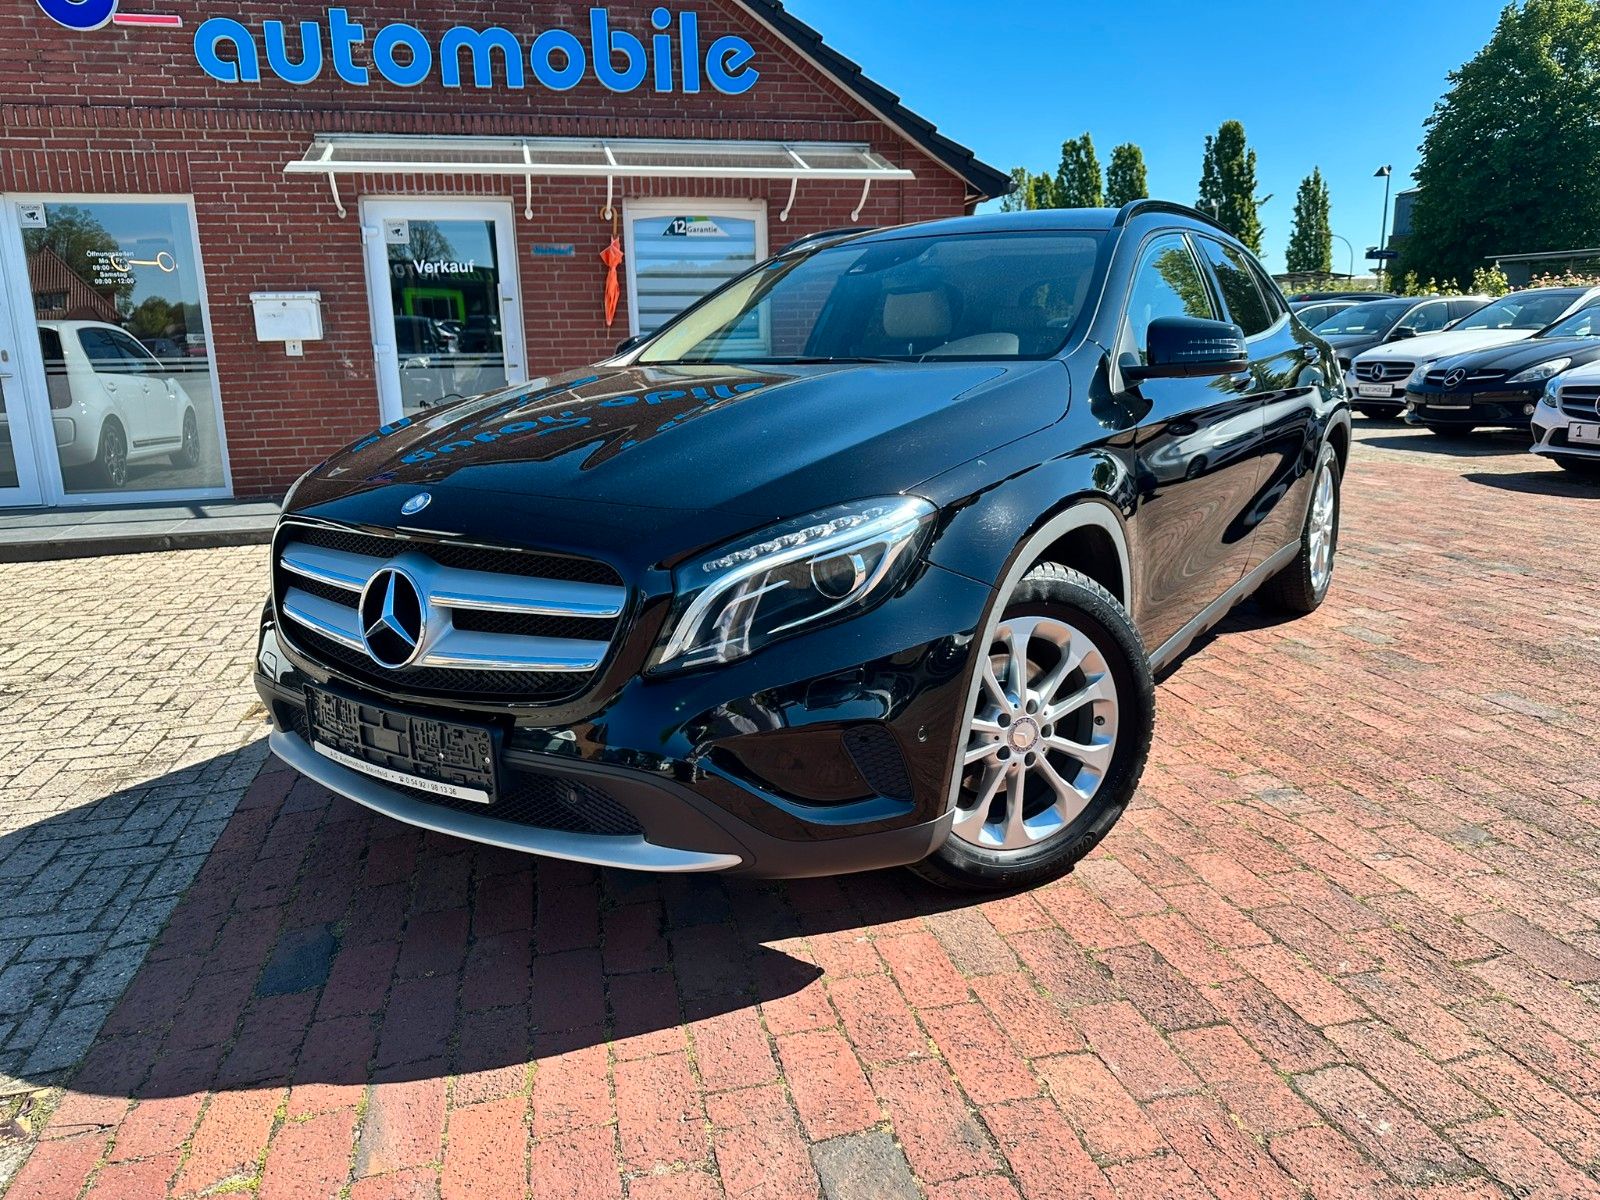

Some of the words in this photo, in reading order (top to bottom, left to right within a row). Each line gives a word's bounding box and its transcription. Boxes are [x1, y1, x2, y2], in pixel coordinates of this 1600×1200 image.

[193, 6, 760, 95] automobile
[673, 220, 686, 234] 12
[413, 259, 474, 273] Verkauf
[99, 271, 128, 279] Samstag
[1576, 424, 1583, 438] 1
[411, 778, 418, 786] 54
[419, 780, 427, 788] 92
[430, 783, 438, 791] 98
[449, 787, 457, 796] 36
